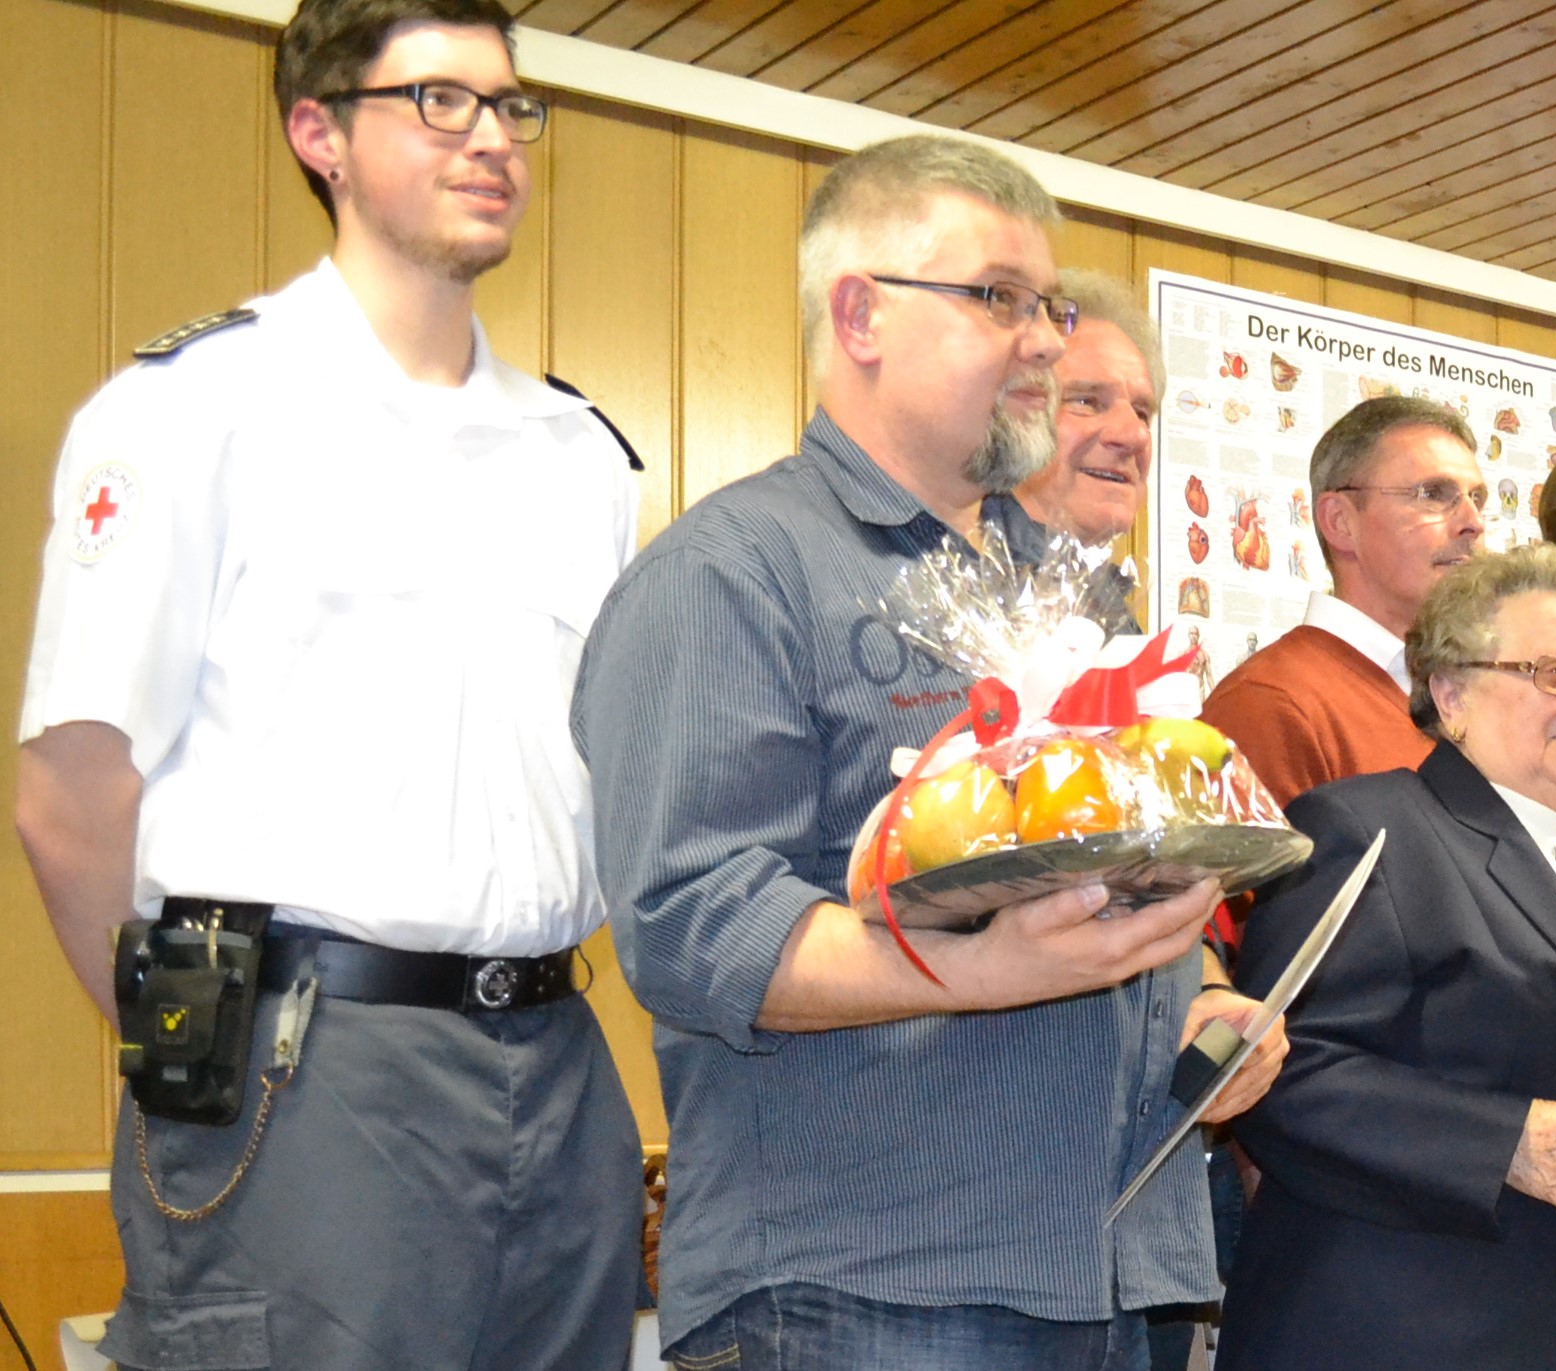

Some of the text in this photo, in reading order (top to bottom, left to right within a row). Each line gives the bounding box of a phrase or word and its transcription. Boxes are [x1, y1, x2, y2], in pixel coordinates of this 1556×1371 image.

[1247, 314, 1290, 344] Der
[1297, 325, 1376, 363] Körper
[1381, 346, 1422, 372] des
[1428, 354, 1534, 398] Menschen
